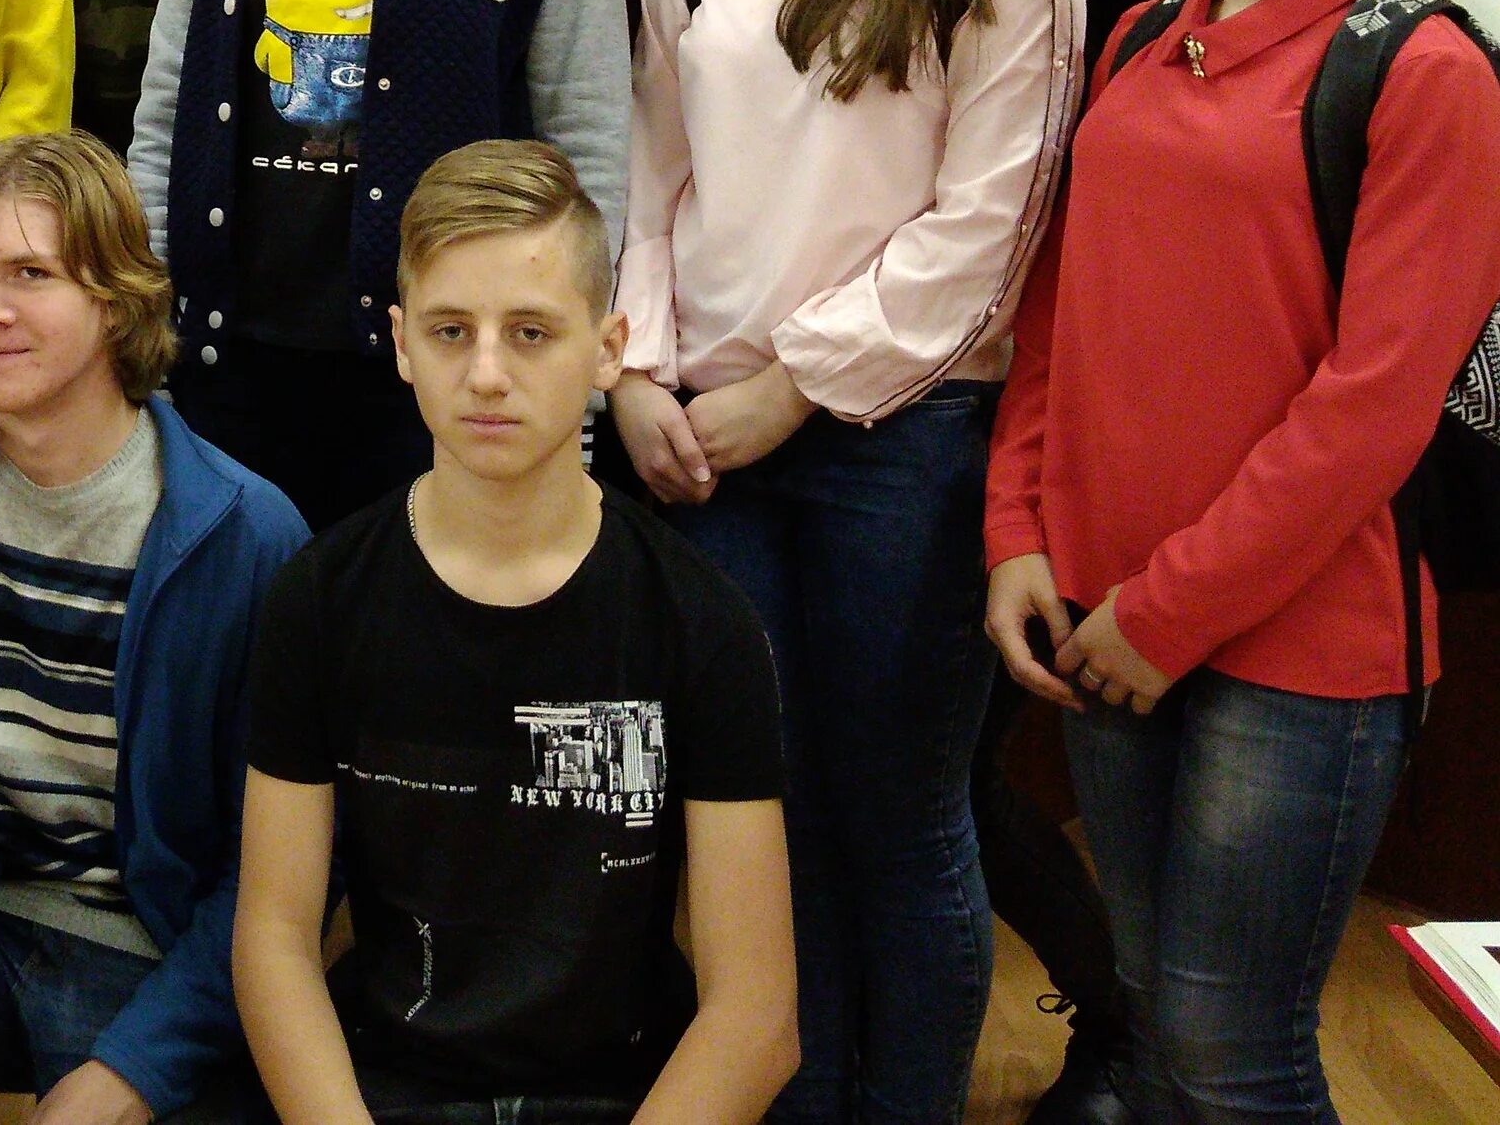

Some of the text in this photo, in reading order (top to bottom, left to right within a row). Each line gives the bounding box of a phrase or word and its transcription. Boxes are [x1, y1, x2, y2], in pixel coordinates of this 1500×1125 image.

[402, 779, 429, 789] original
[431, 782, 448, 791] from
[510, 783, 563, 808] NEW
